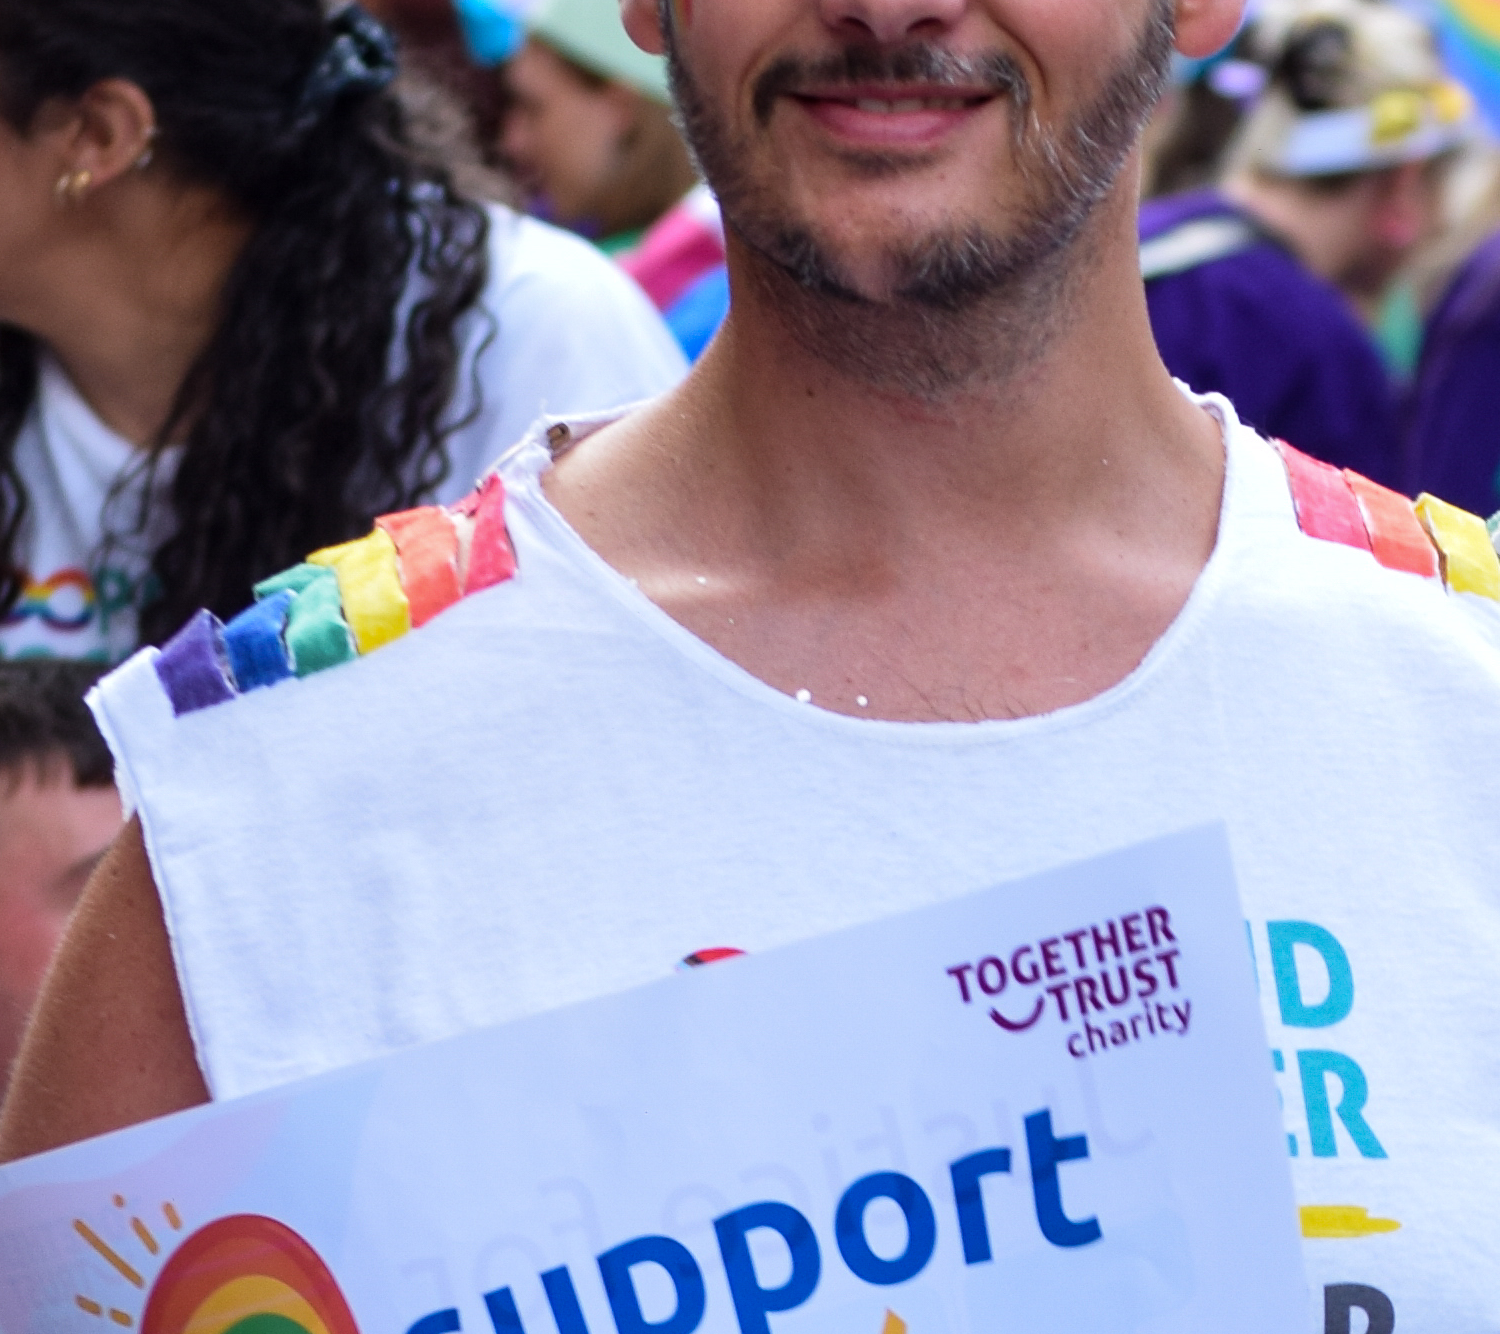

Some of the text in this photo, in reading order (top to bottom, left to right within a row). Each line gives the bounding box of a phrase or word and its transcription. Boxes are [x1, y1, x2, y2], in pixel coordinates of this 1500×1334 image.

[946, 906, 1178, 1004] TOGETHER
[1045, 949, 1181, 1022] TRUST
[1067, 998, 1192, 1058] charity
